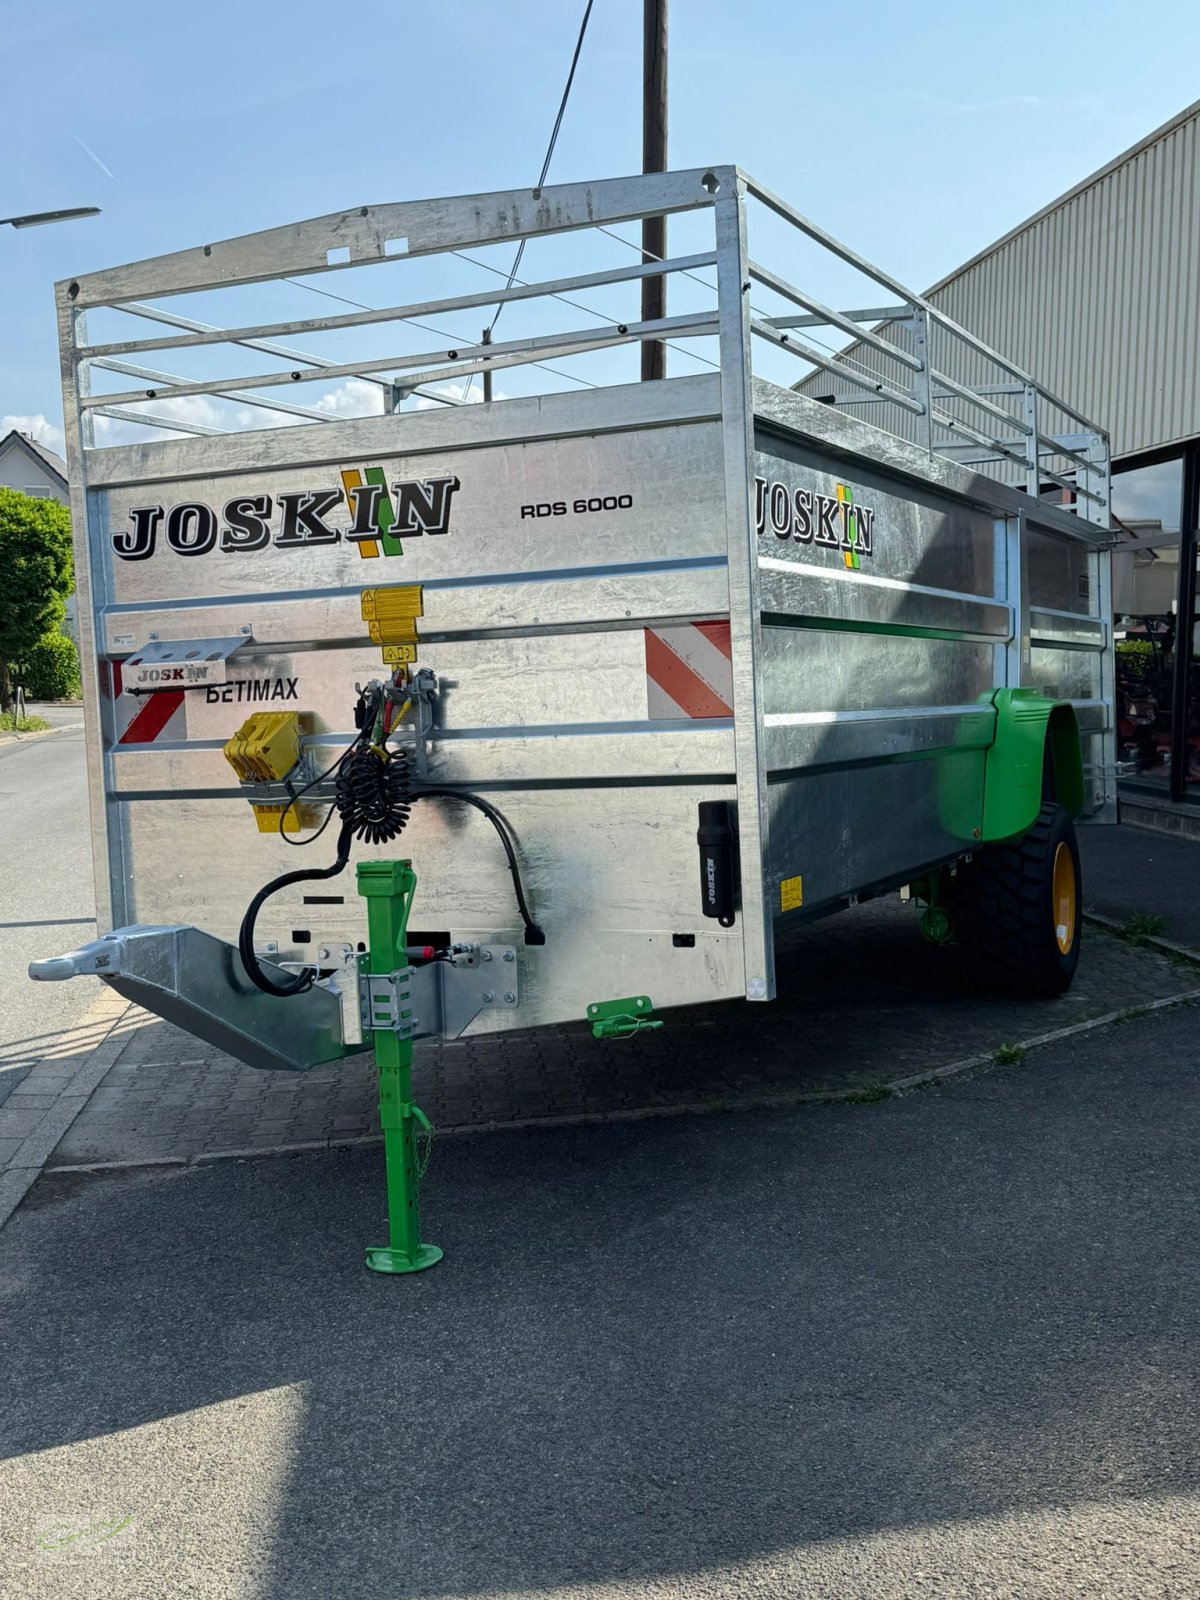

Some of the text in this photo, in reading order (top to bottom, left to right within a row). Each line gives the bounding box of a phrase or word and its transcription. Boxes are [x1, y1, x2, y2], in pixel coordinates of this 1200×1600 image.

[111, 475, 461, 561] JOSKIN
[520, 494, 633, 519] RDS 6000
[755, 475, 875, 557] JOSKIN
[138, 665, 209, 682] JOSKIN
[206, 677, 299, 703] BETIMAX
[706, 857, 716, 905] JOSKIN
